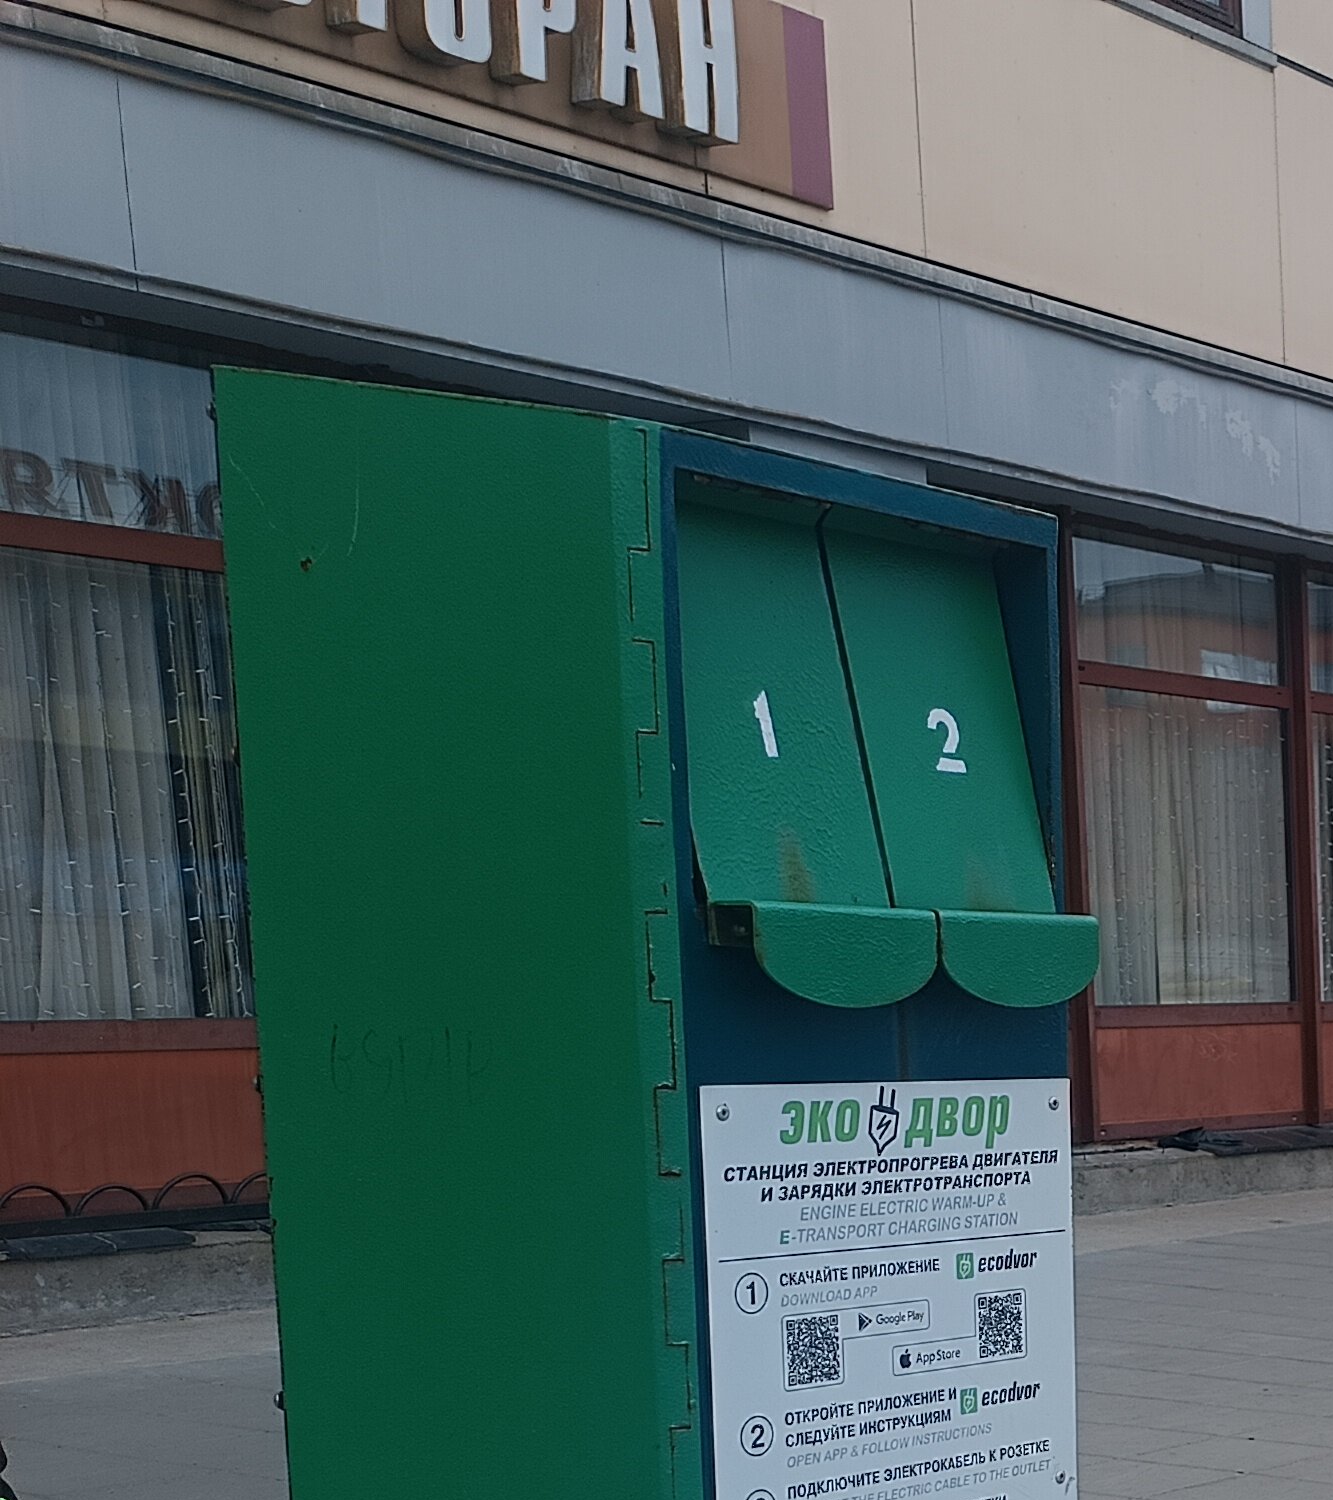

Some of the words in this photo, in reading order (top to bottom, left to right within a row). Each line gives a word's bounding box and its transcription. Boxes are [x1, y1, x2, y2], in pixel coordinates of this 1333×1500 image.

[753, 690, 779, 758] 1
[927, 708, 967, 774] 2
[723, 1163, 808, 1183] СТАНЦИЯ
[812, 1154, 969, 1178] ЭЛЕКТРОПРОГРЕВА
[972, 1150, 1059, 1170] ДВИГАТЕЛЯ
[761, 1187, 774, 1202] И
[777, 1180, 856, 1201] ЗАРЯДКИ
[861, 1171, 1032, 1196] ЭЛЕКТРОТРАНСПОРТА
[800, 1203, 857, 1221] ENGINE
[860, 1198, 928, 1216] ELECTRIC
[931, 1193, 996, 1212] WARM-UP
[997, 1193, 1007, 1206] &
[779, 1223, 886, 1245] E-TRANSPORT
[888, 1217, 961, 1237] CHARGING
[964, 1211, 1019, 1230] STATION
[779, 1265, 849, 1288] СКАЧАЙТЕ
[852, 1258, 941, 1279] ПРИЛОЖЕНИЕ
[977, 1248, 1038, 1273] ecodvor
[746, 1281, 756, 1305] 1
[781, 1289, 852, 1307] DOWNLOAD
[854, 1285, 878, 1299] APP
[876, 1311, 906, 1326] Google
[907, 1309, 925, 1323] Play
[916, 1350, 935, 1366] App
[936, 1348, 961, 1362] Store
[785, 1402, 855, 1426] ОТКРОЙТЕ
[858, 1388, 946, 1416] ПРИЛОЖЕНИЕ
[949, 1387, 958, 1401] И
[981, 1381, 1041, 1407] ecodvor
[750, 1424, 765, 1449] 2
[785, 1422, 855, 1448] СЛЕДУЙТЕ
[859, 1408, 951, 1436] ИНСТРУКЦИЯМ
[787, 1452, 822, 1469] OPEN
[824, 1448, 848, 1463] APP
[851, 1446, 860, 1458] &
[861, 1436, 910, 1455] FOLLOW
[911, 1422, 992, 1447] INSTRUCTIONS
[788, 1470, 881, 1500] ПОДКЛЮЧИТЕ
[884, 1451, 986, 1482] ЭЛЕКТРОКАБЕЛЬ
[989, 1449, 998, 1462] К
[1000, 1439, 1050, 1459] РОЗЕТКЕ
[934, 1474, 971, 1491] CABLE
[973, 1471, 988, 1484] TO
[990, 1466, 1011, 1481] THE
[1012, 1459, 1051, 1476] OUTLET
